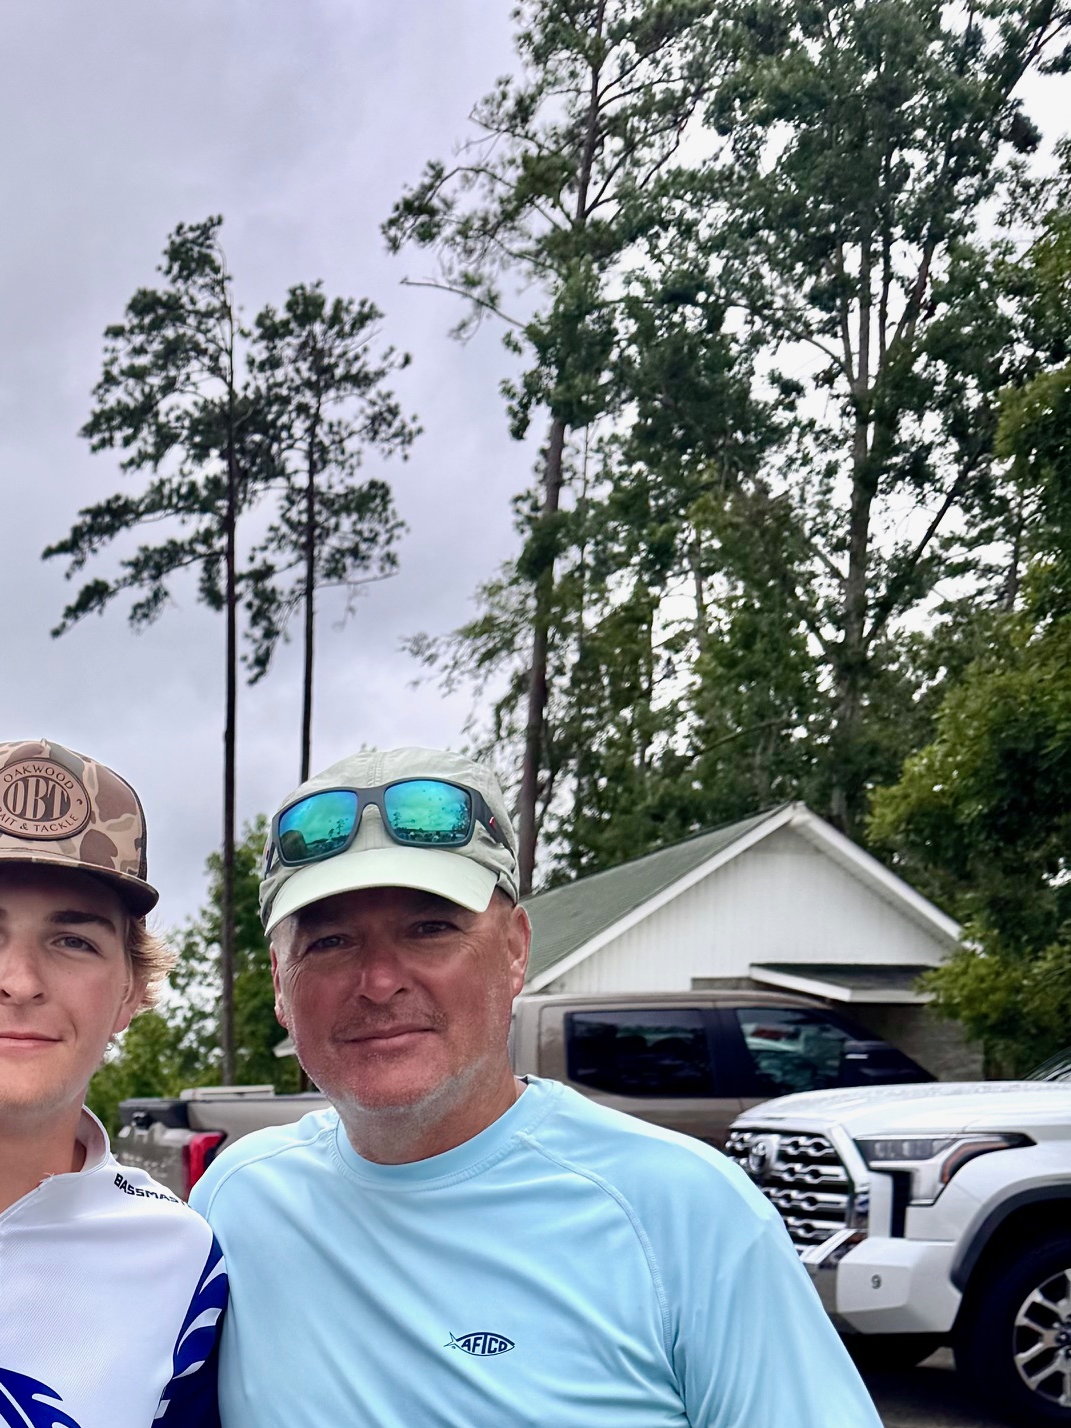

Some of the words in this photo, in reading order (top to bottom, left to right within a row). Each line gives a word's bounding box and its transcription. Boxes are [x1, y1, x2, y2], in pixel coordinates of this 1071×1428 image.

[3, 764, 74, 790] OAKWOOD
[6, 777, 68, 821] OBT
[19, 822, 28, 831] &
[34, 813, 79, 832] TACKLE
[458, 1332, 512, 1355] AFTCO
